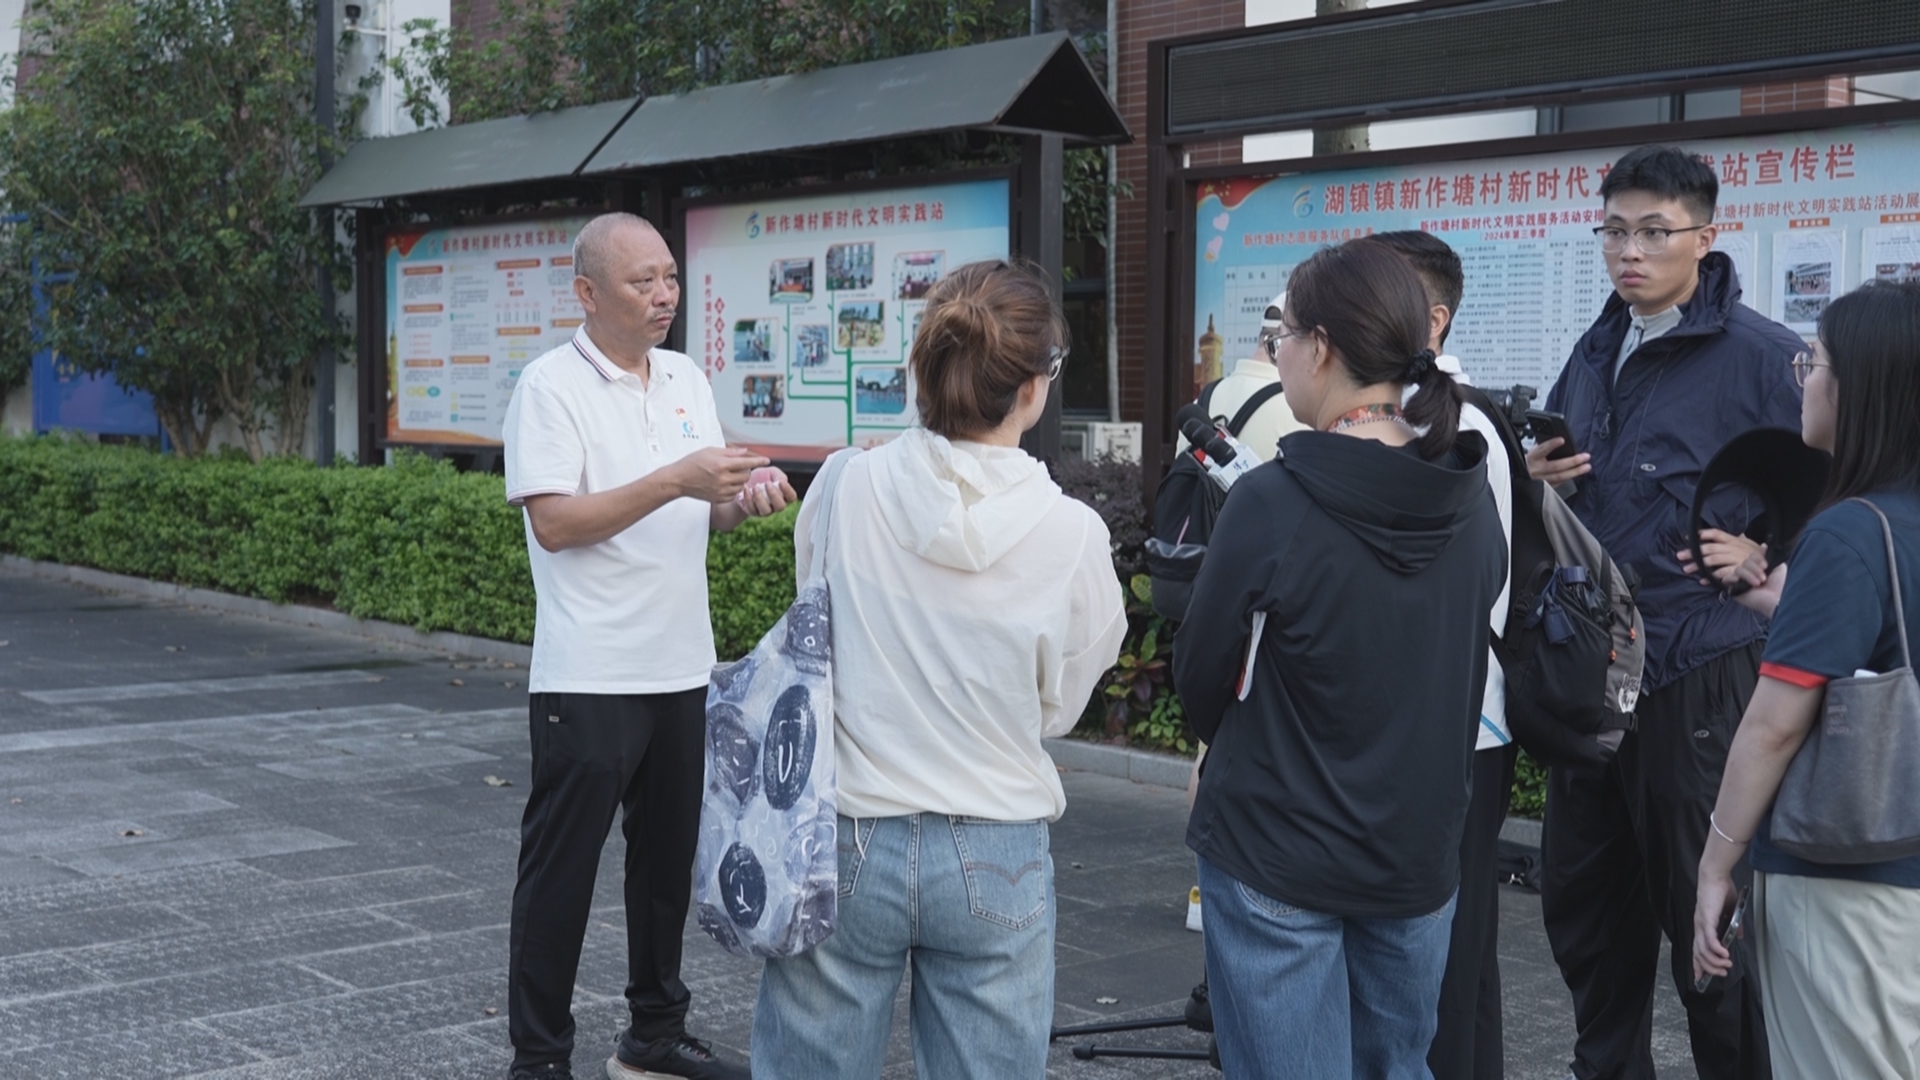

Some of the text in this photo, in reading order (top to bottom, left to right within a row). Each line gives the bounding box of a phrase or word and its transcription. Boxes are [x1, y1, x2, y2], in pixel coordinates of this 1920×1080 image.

[1705, 143, 1856, 187] 站宣传栏
[764, 202, 944, 233] 新作塘村新时代文明实践站
